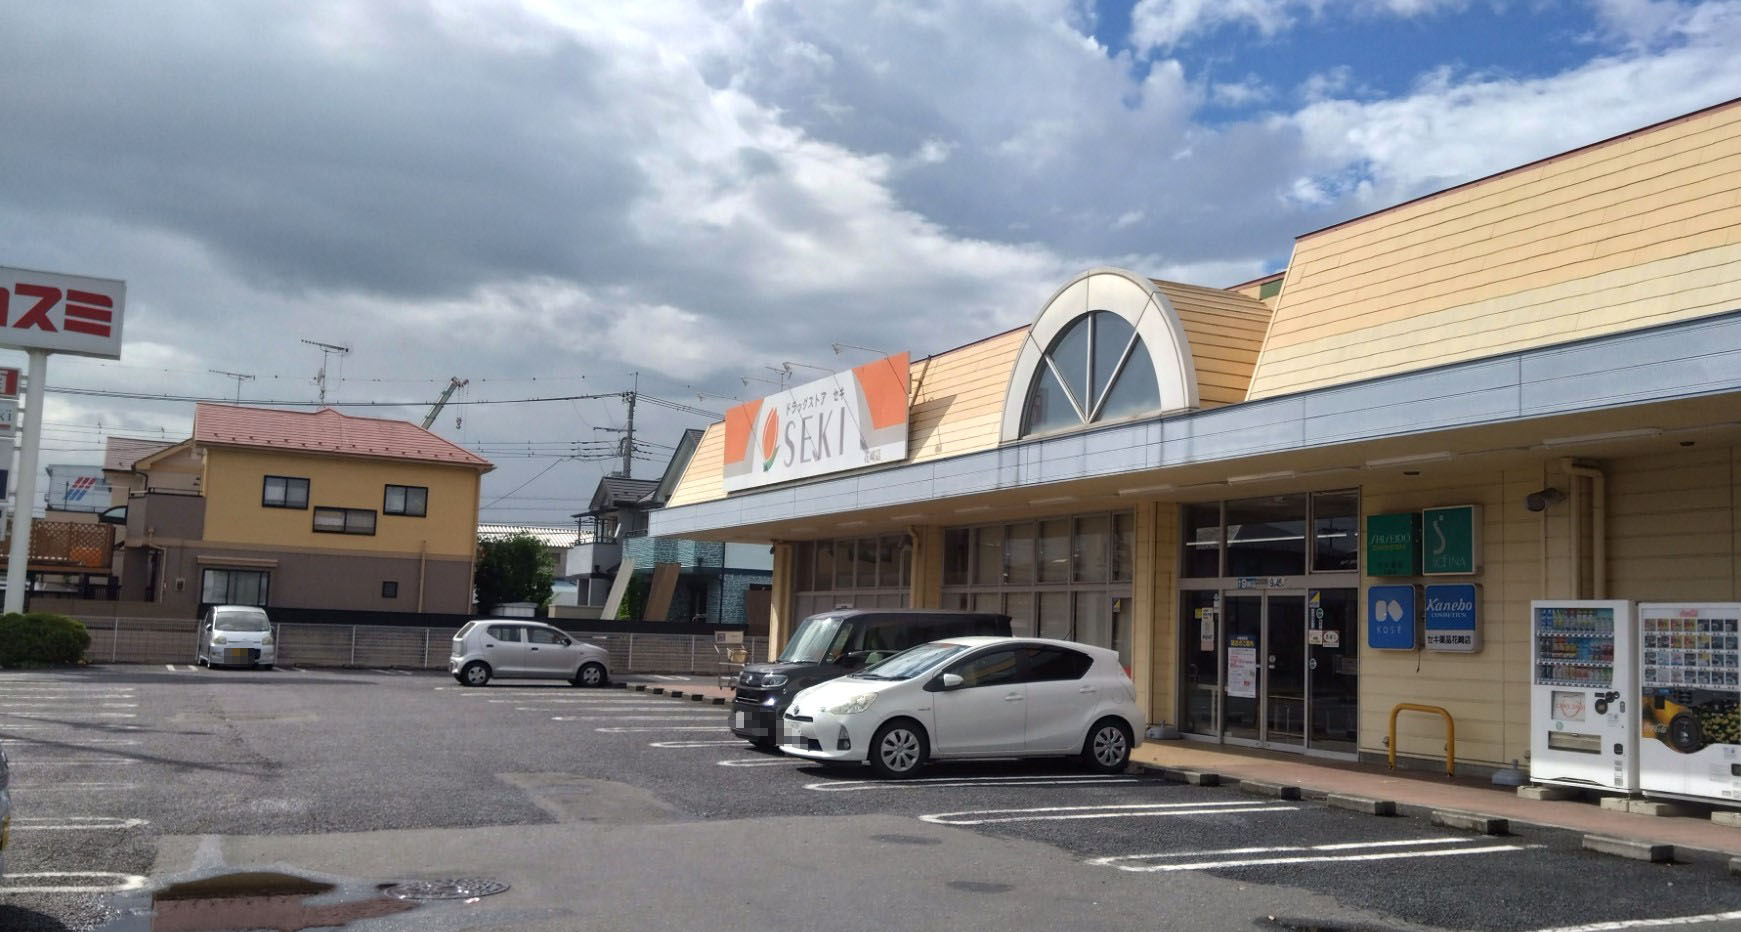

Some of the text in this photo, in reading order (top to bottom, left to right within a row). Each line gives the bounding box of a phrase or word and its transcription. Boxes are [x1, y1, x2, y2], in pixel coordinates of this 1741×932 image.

[0, 283, 113, 337] スミ
[786, 392, 827, 415] ドラッグストア
[784, 407, 845, 468] SEKI
[1426, 598, 1473, 612] Kanebo
